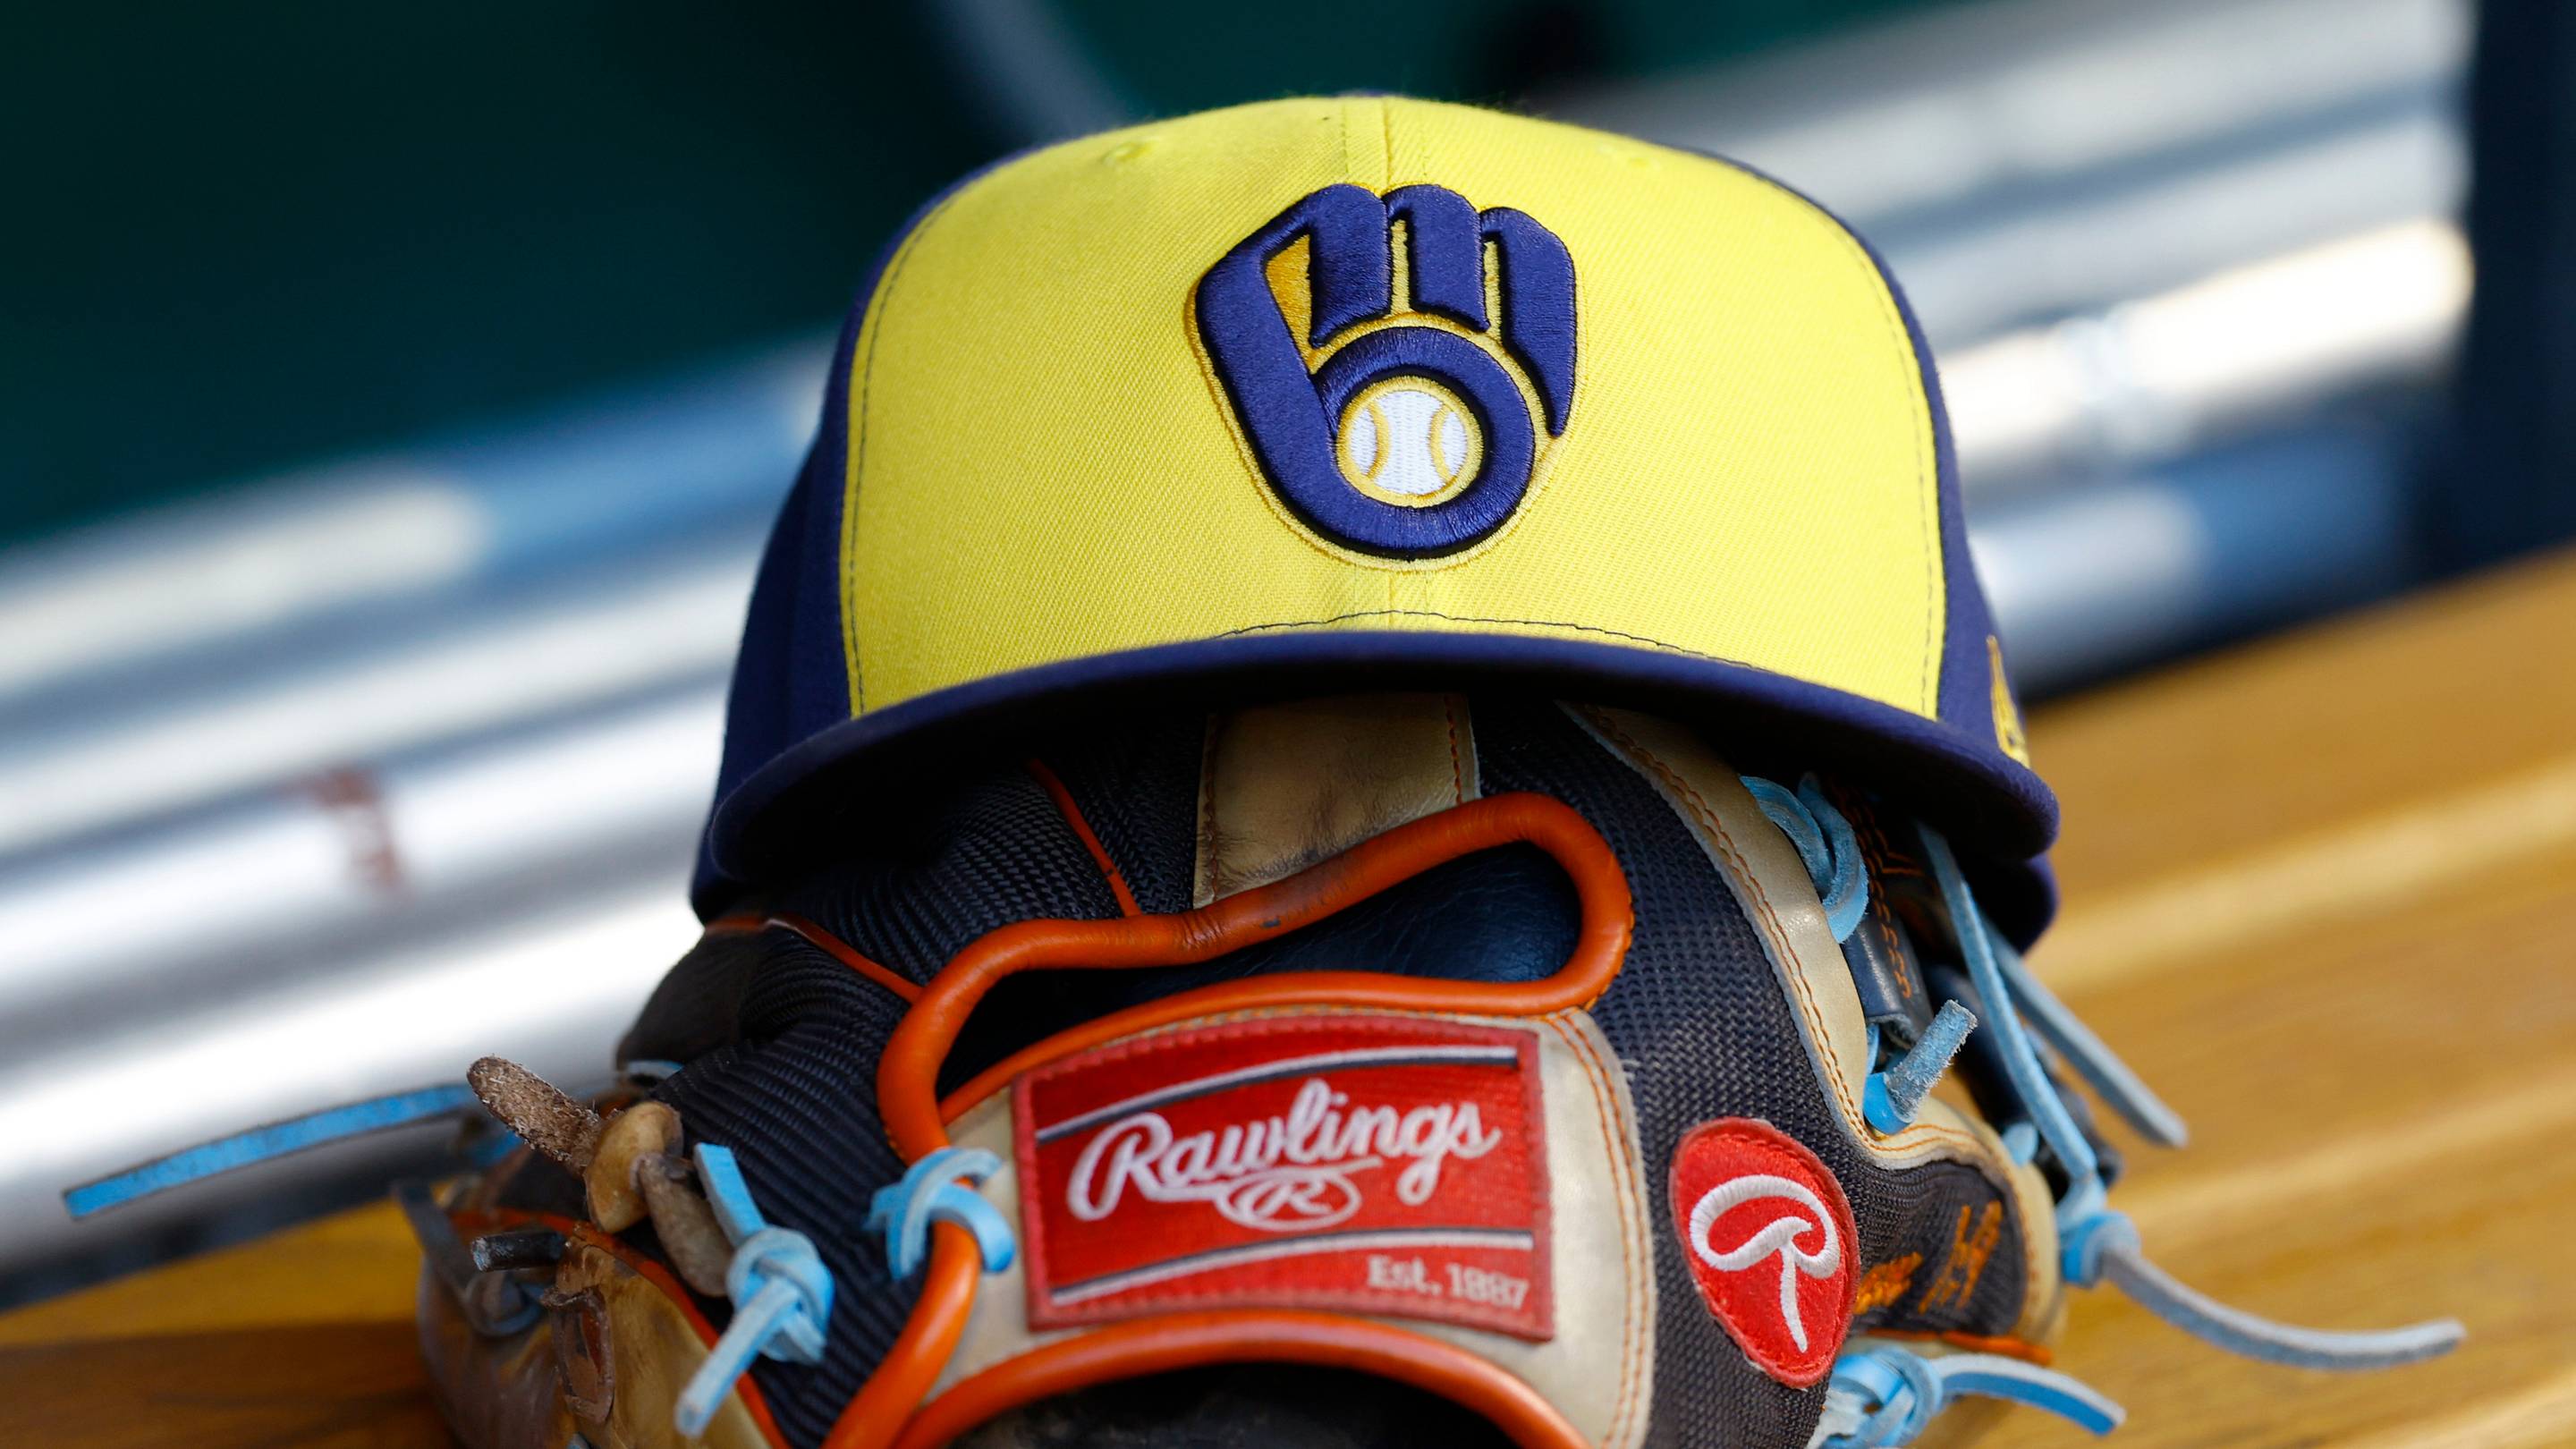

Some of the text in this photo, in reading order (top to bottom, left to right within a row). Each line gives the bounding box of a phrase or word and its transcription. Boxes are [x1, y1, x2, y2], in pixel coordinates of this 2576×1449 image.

[1067, 1078, 1503, 1222] Rawlings
[1367, 1254, 1530, 1309] Est. 1887
